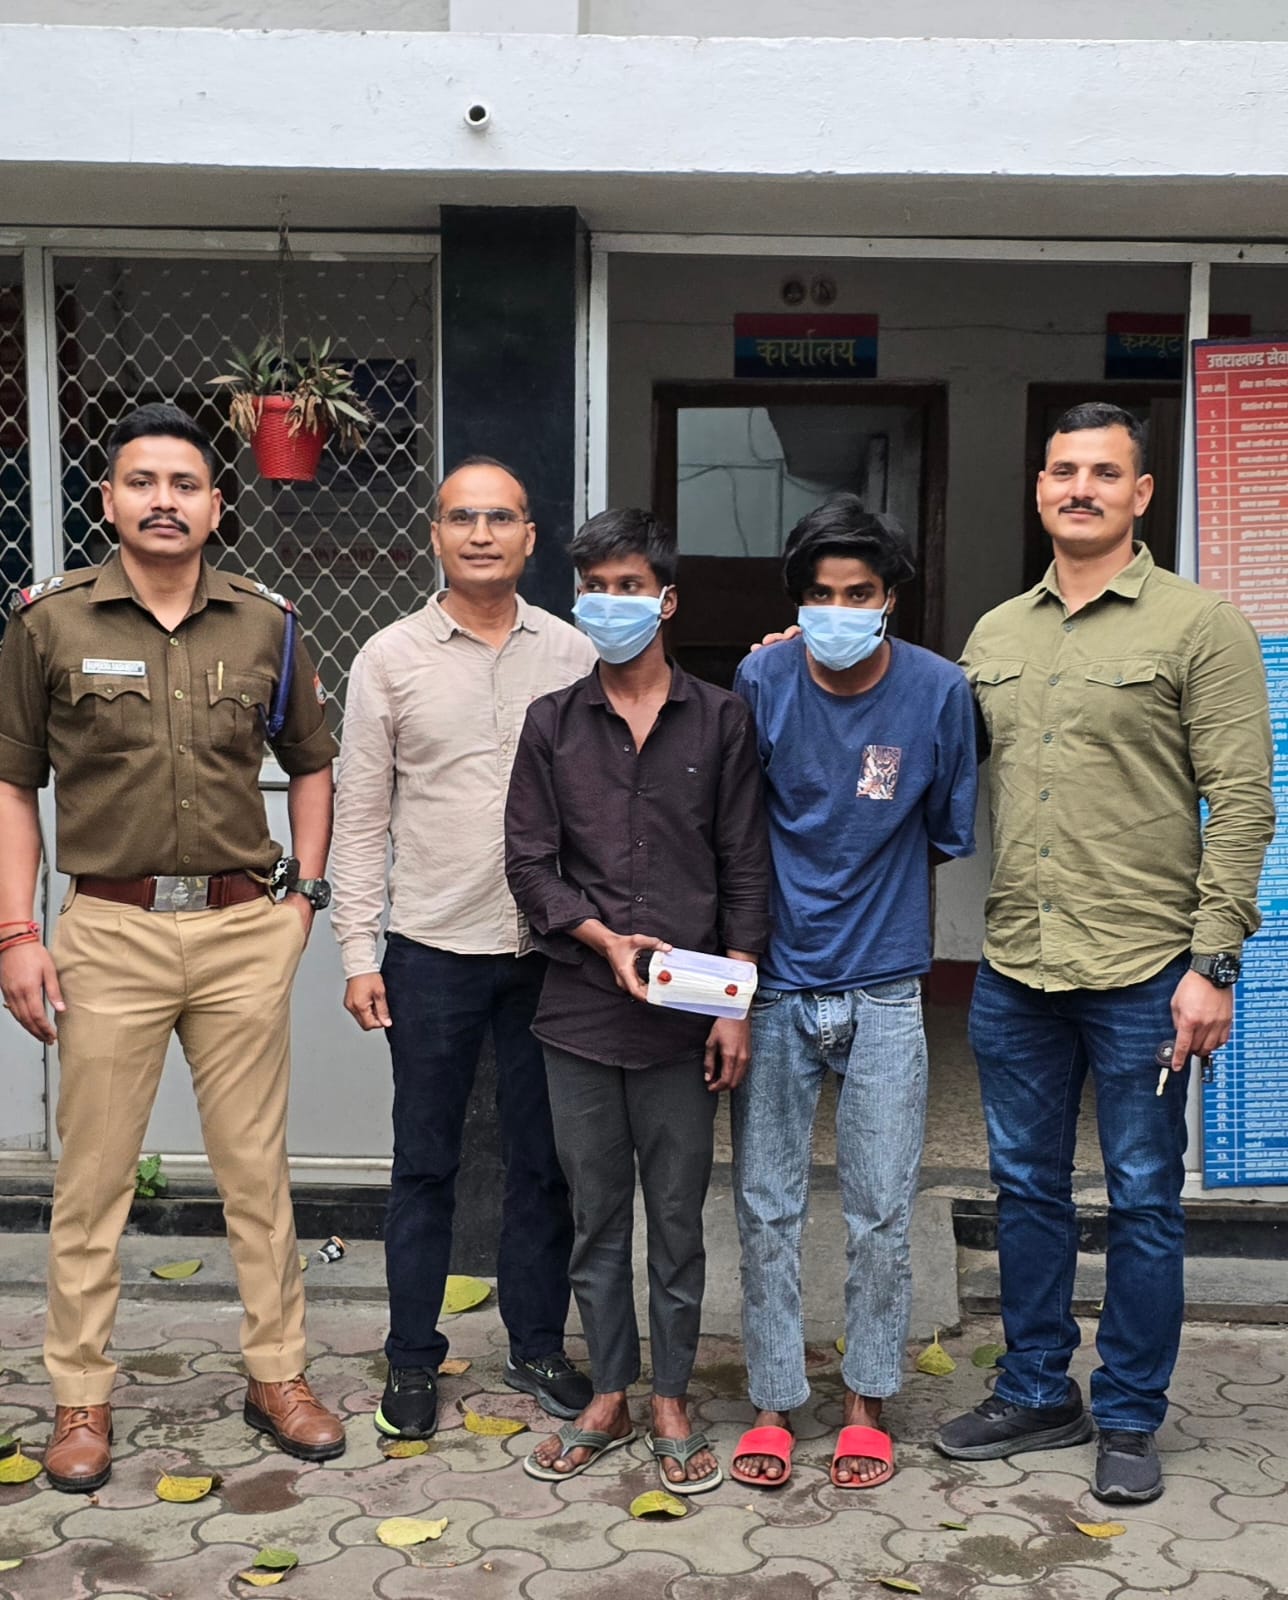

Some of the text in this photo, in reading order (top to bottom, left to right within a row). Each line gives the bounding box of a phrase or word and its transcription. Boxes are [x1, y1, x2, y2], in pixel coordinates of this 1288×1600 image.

[756, 329, 856, 366] कार्यालय
[1120, 334, 1183, 358] कम्प्यूट
[1207, 352, 1264, 368] उत्तराखण्ड
